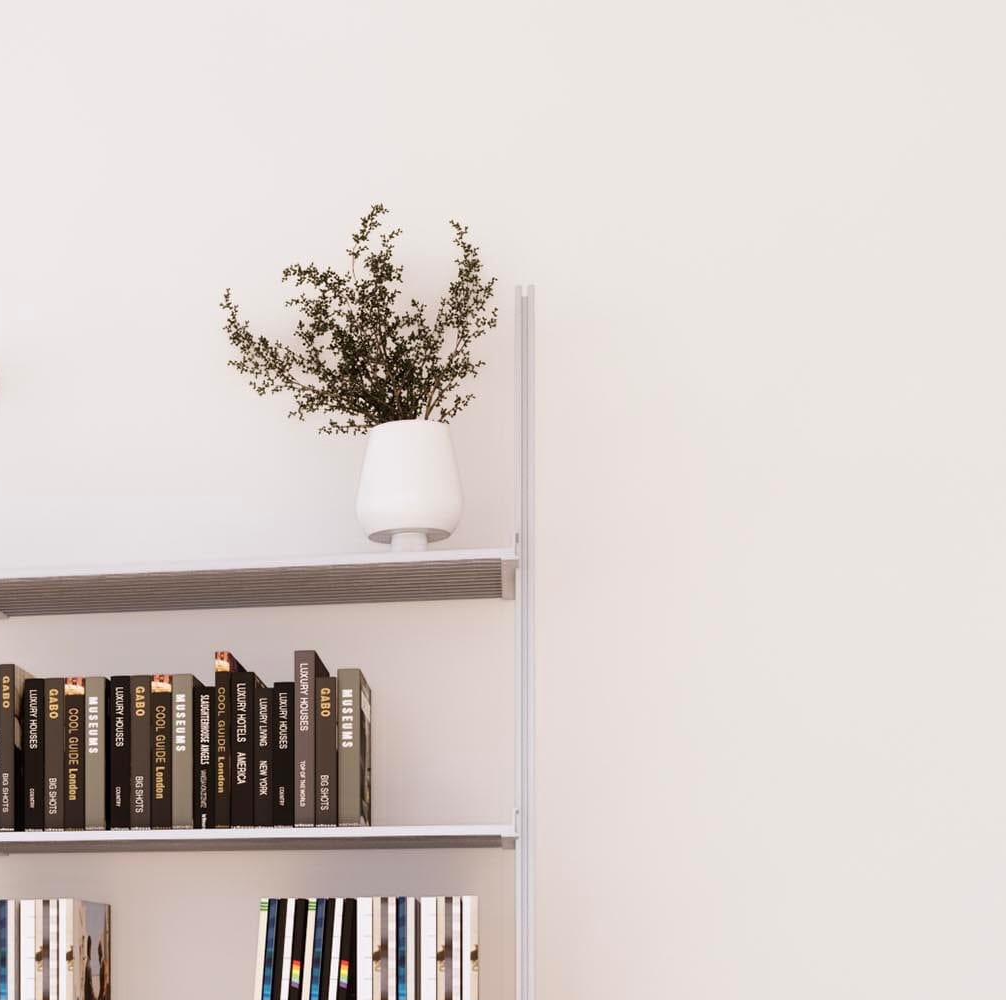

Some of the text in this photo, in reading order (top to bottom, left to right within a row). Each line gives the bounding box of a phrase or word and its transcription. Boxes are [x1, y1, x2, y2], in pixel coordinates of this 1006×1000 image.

[2, 676, 10, 709] GABO
[49, 688, 58, 719] GABO
[115, 686, 124, 747] LUXURY HOUSES
[135, 686, 145, 717] GABO
[236, 683, 246, 743] LUXURY HOTELS
[300, 663, 309, 731] LUXURY HOUSES
[320, 687, 330, 717] GABO
[29, 689, 38, 749] LUXURY HOUSES
[88, 696, 99, 754] MUSEUMS
[175, 694, 186, 752] MUSEUMS
[200, 694, 210, 743] SLAUGHTERHOUSE
[217, 687, 226, 794] COOL GUIDE London
[259, 698, 267, 747] LUXURY LIVING
[278, 692, 288, 750] LUXURY HOUSES
[341, 689, 353, 748] MUSEUMS
[68, 708, 79, 801] COOL GUIDE London
[155, 705, 166, 799] COOL GUIDE London
[200, 744, 210, 765] ANGELS
[236, 752, 246, 785] AMERICA
[48, 777, 57, 815] BIG SHOTS
[135, 775, 143, 813] BIG SHOTS
[259, 760, 267, 796] NEW YORK
[320, 774, 329, 811] BIG SHOTS
